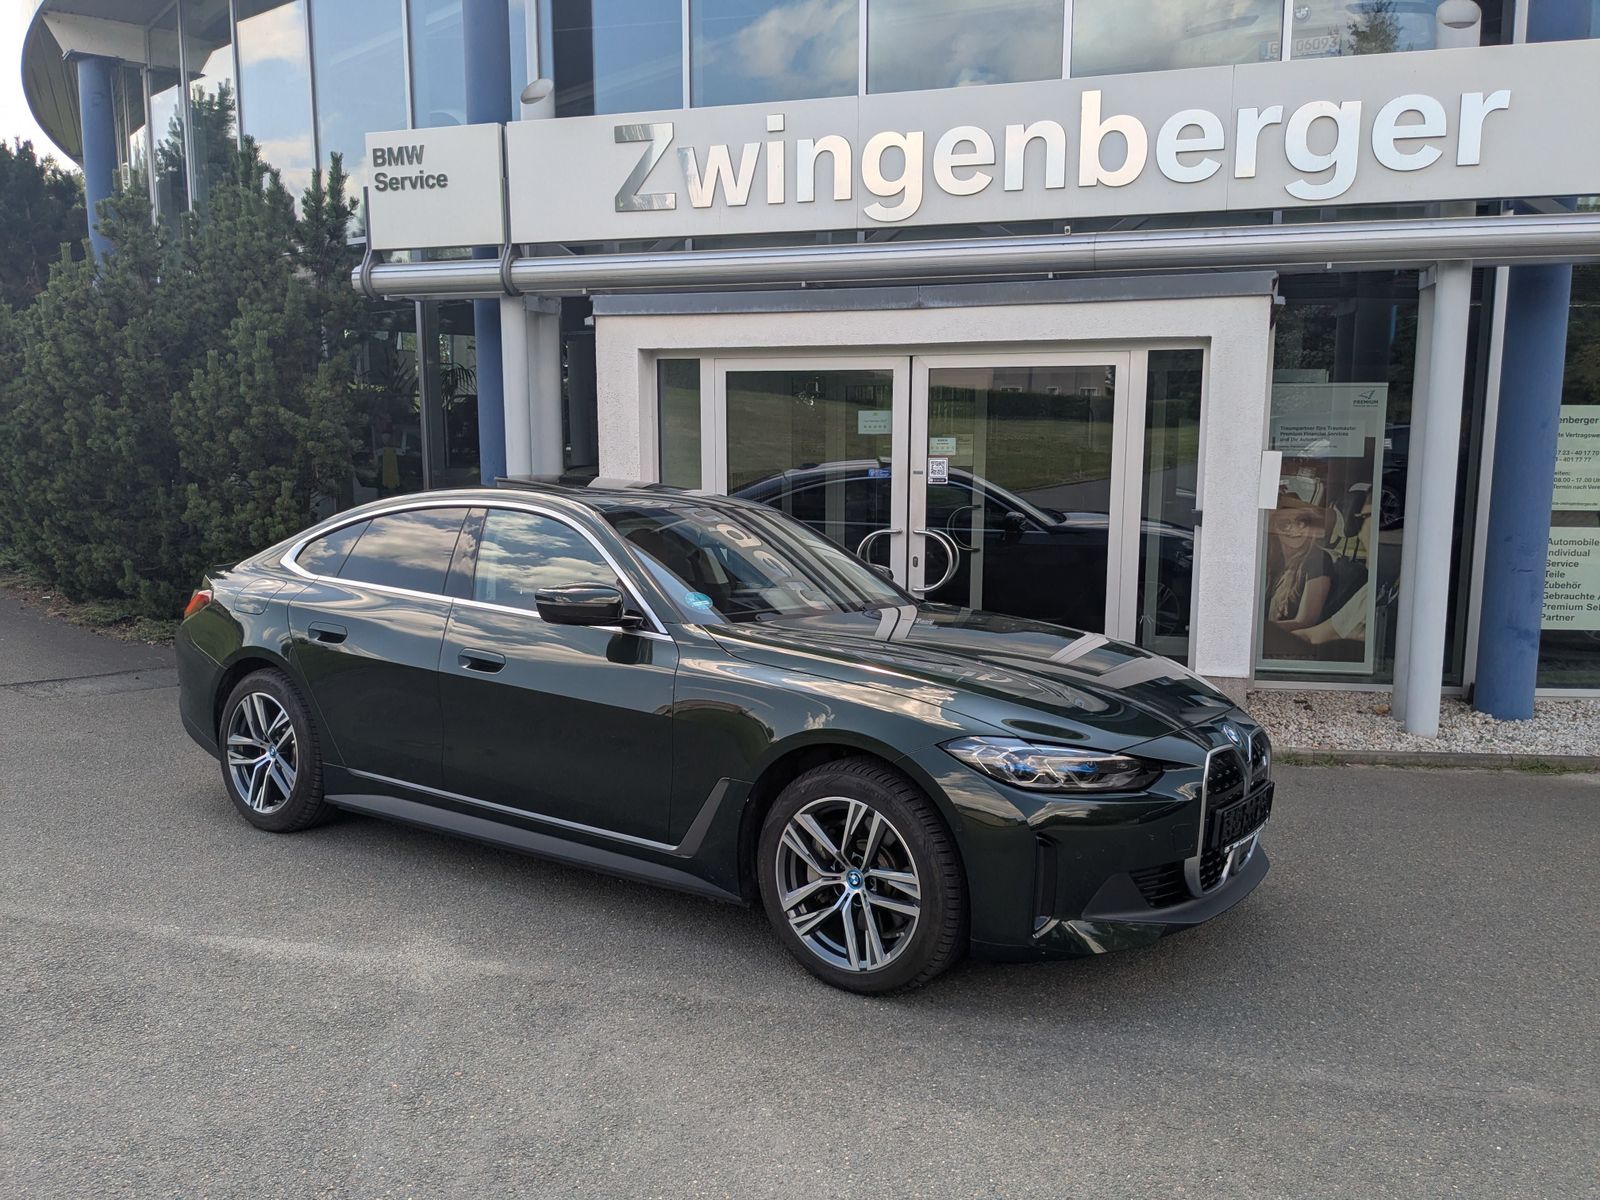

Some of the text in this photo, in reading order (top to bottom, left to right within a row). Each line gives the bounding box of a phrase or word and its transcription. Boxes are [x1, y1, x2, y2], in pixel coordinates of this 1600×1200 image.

[372, 144, 425, 168] BMW
[614, 90, 1512, 221] Zwingenberger
[374, 170, 449, 192] Service
[1548, 549, 1591, 557] ndividual
[1546, 560, 1580, 568] Service
[1545, 570, 1566, 579] Teile
[1543, 581, 1582, 590] Zubehör
[1543, 592, 1595, 601] Gebrauchte
[1541, 603, 1584, 611] Premium
[1540, 613, 1576, 621] Partner
